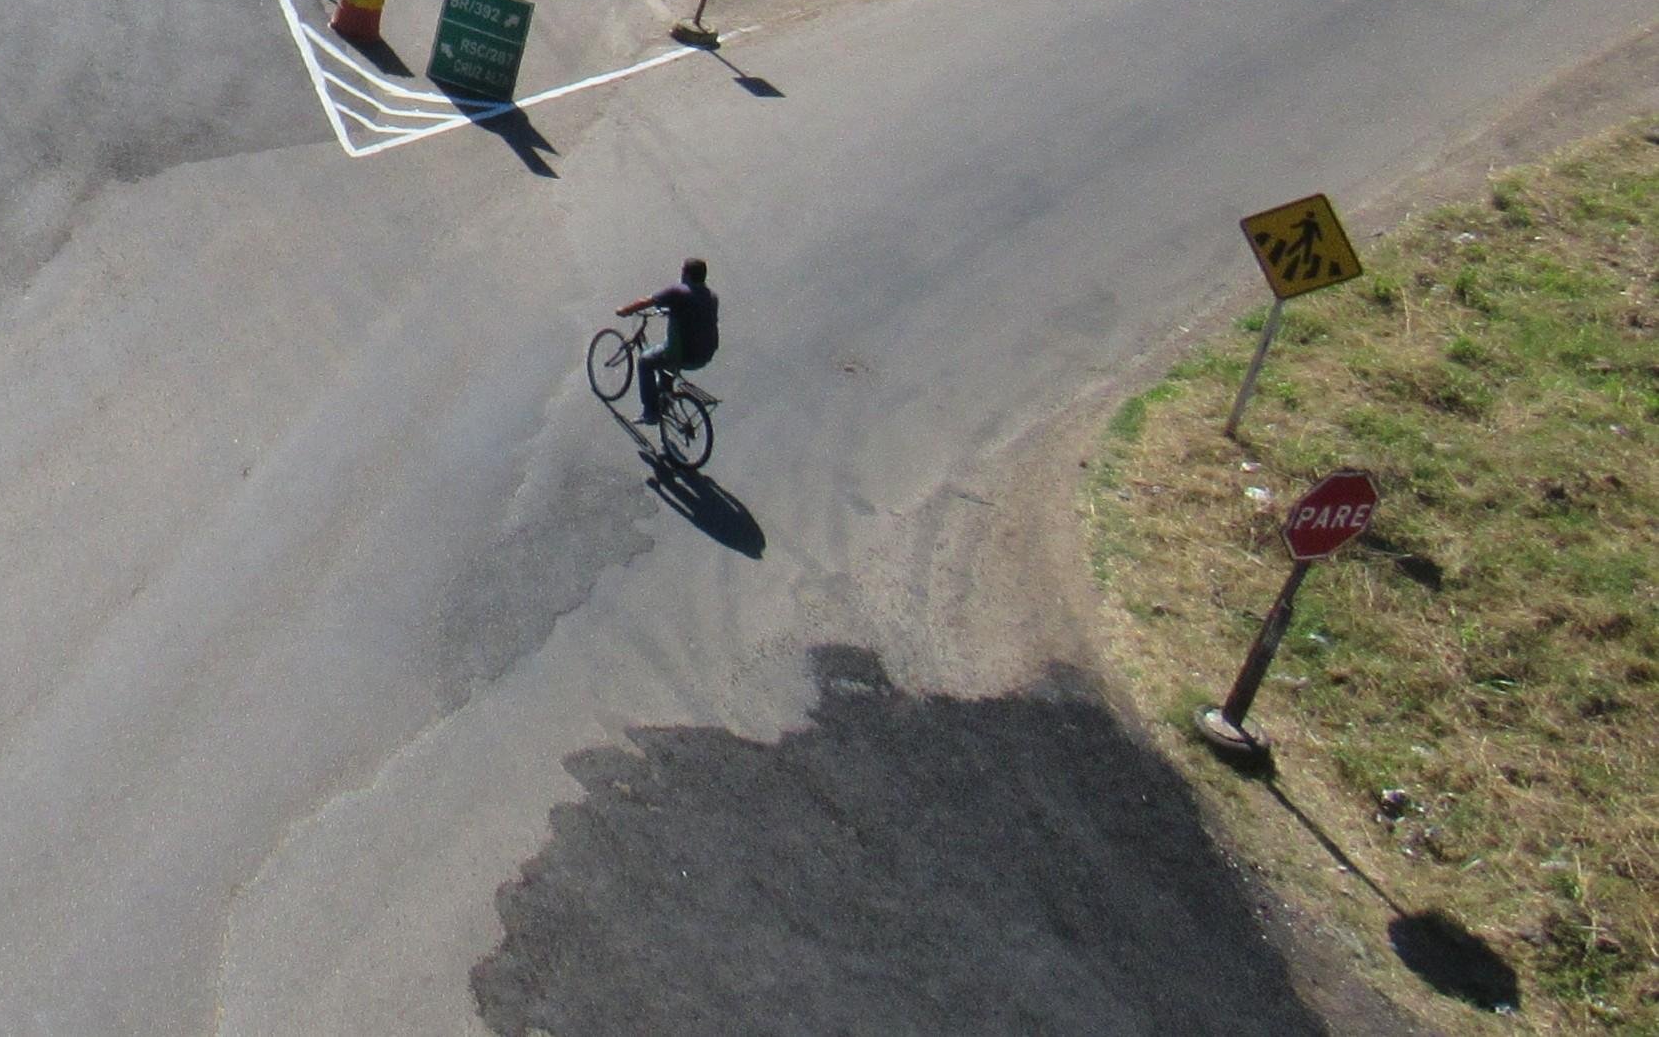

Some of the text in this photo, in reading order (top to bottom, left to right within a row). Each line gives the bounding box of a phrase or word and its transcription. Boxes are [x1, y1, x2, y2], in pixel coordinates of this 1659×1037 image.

[459, 37, 514, 66] RSC/287
[453, 59, 483, 80] CRUZ
[1294, 503, 1371, 530] PARE
